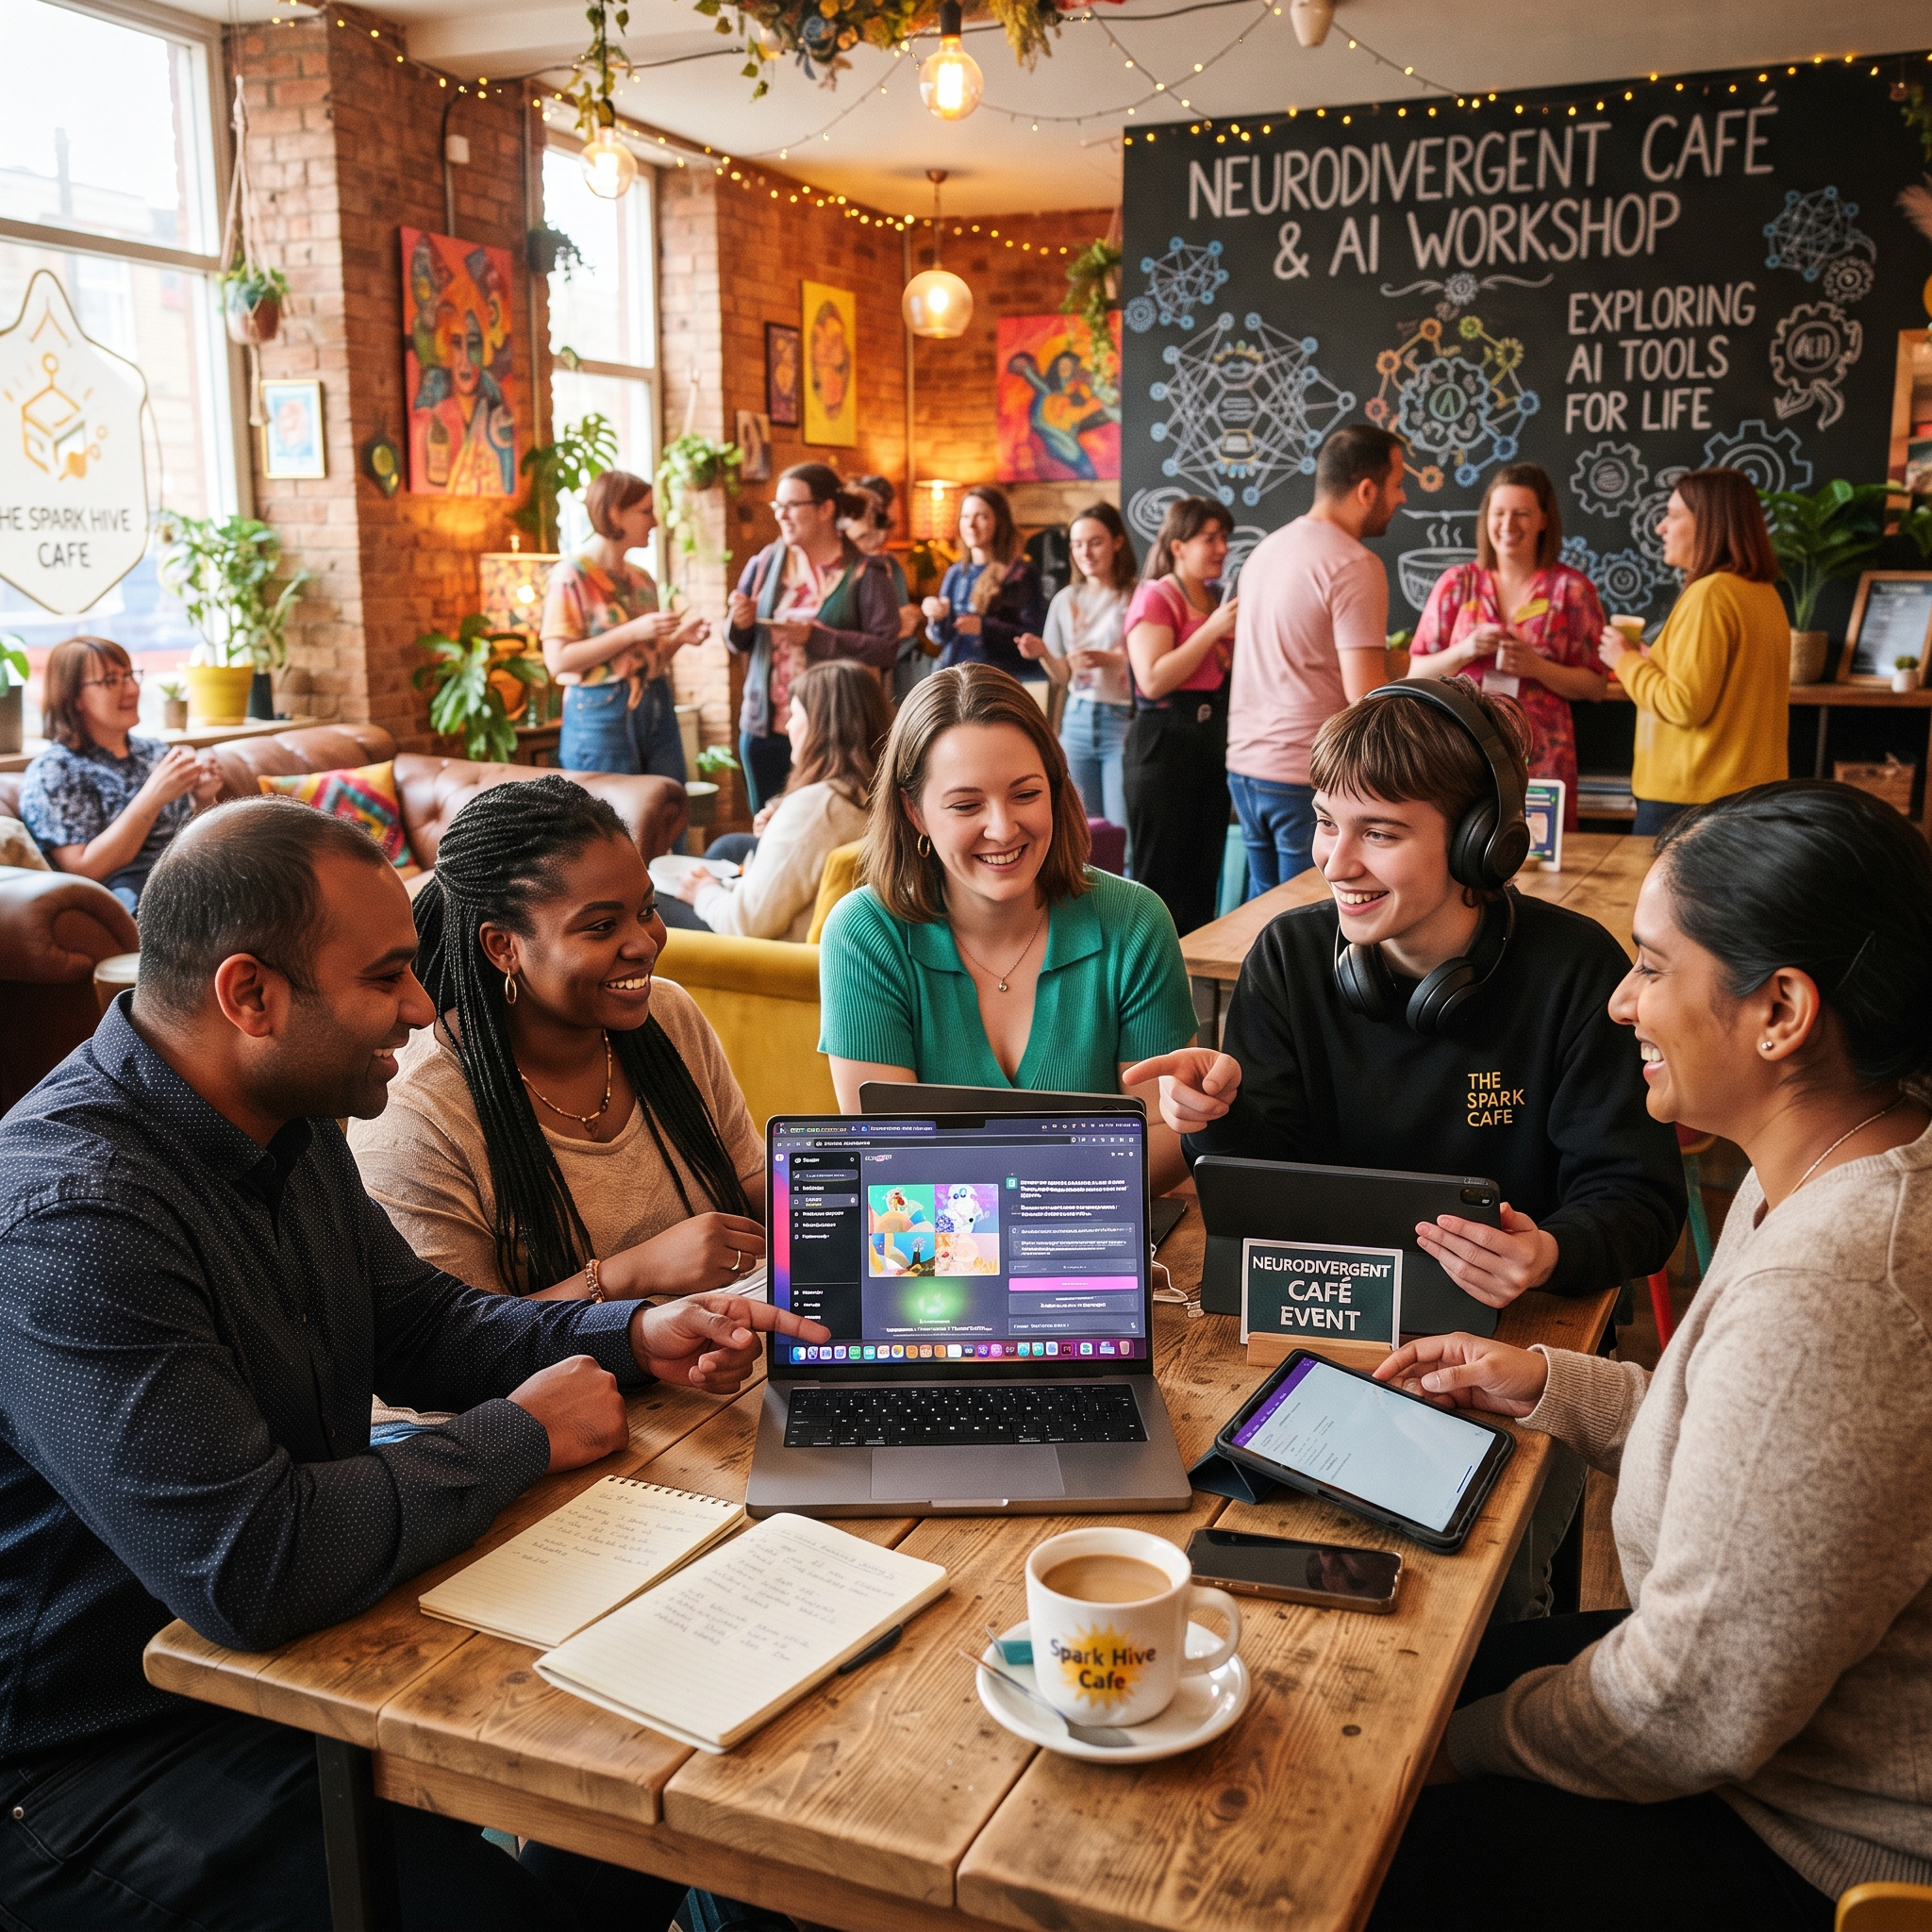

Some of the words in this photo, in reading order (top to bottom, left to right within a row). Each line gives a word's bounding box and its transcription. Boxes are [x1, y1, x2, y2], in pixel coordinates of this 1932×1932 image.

[1189, 122, 1613, 220] NEURODIVERGENT
[1641, 90, 1779, 183] CAFÉ
[1274, 220, 1309, 280] &
[1328, 214, 1380, 277] AI
[1406, 191, 1681, 271] WORKSHOP
[1568, 281, 1757, 335] EXPLORING
[1566, 342, 1603, 384] AI
[1618, 334, 1730, 382] TOOLS
[1565, 391, 1628, 435] FOR
[1641, 388, 1714, 431] LIFE
[0, 507, 23, 531] HE
[28, 507, 88, 532] SPARK
[90, 508, 131, 532] HIVE
[38, 541, 92, 569] CAFE
[1467, 1071, 1501, 1090] THE
[1467, 1089, 1525, 1109] SPARK
[1467, 1109, 1513, 1127] CAFE
[1253, 1256, 1392, 1278] NEURODIVERGENT
[1288, 1276, 1352, 1304] CAFÉ
[1280, 1306, 1361, 1331] EVENT
[1050, 1639, 1104, 1666] Spark
[1112, 1647, 1157, 1666] Hive
[1078, 1670, 1126, 1690] Cafe
